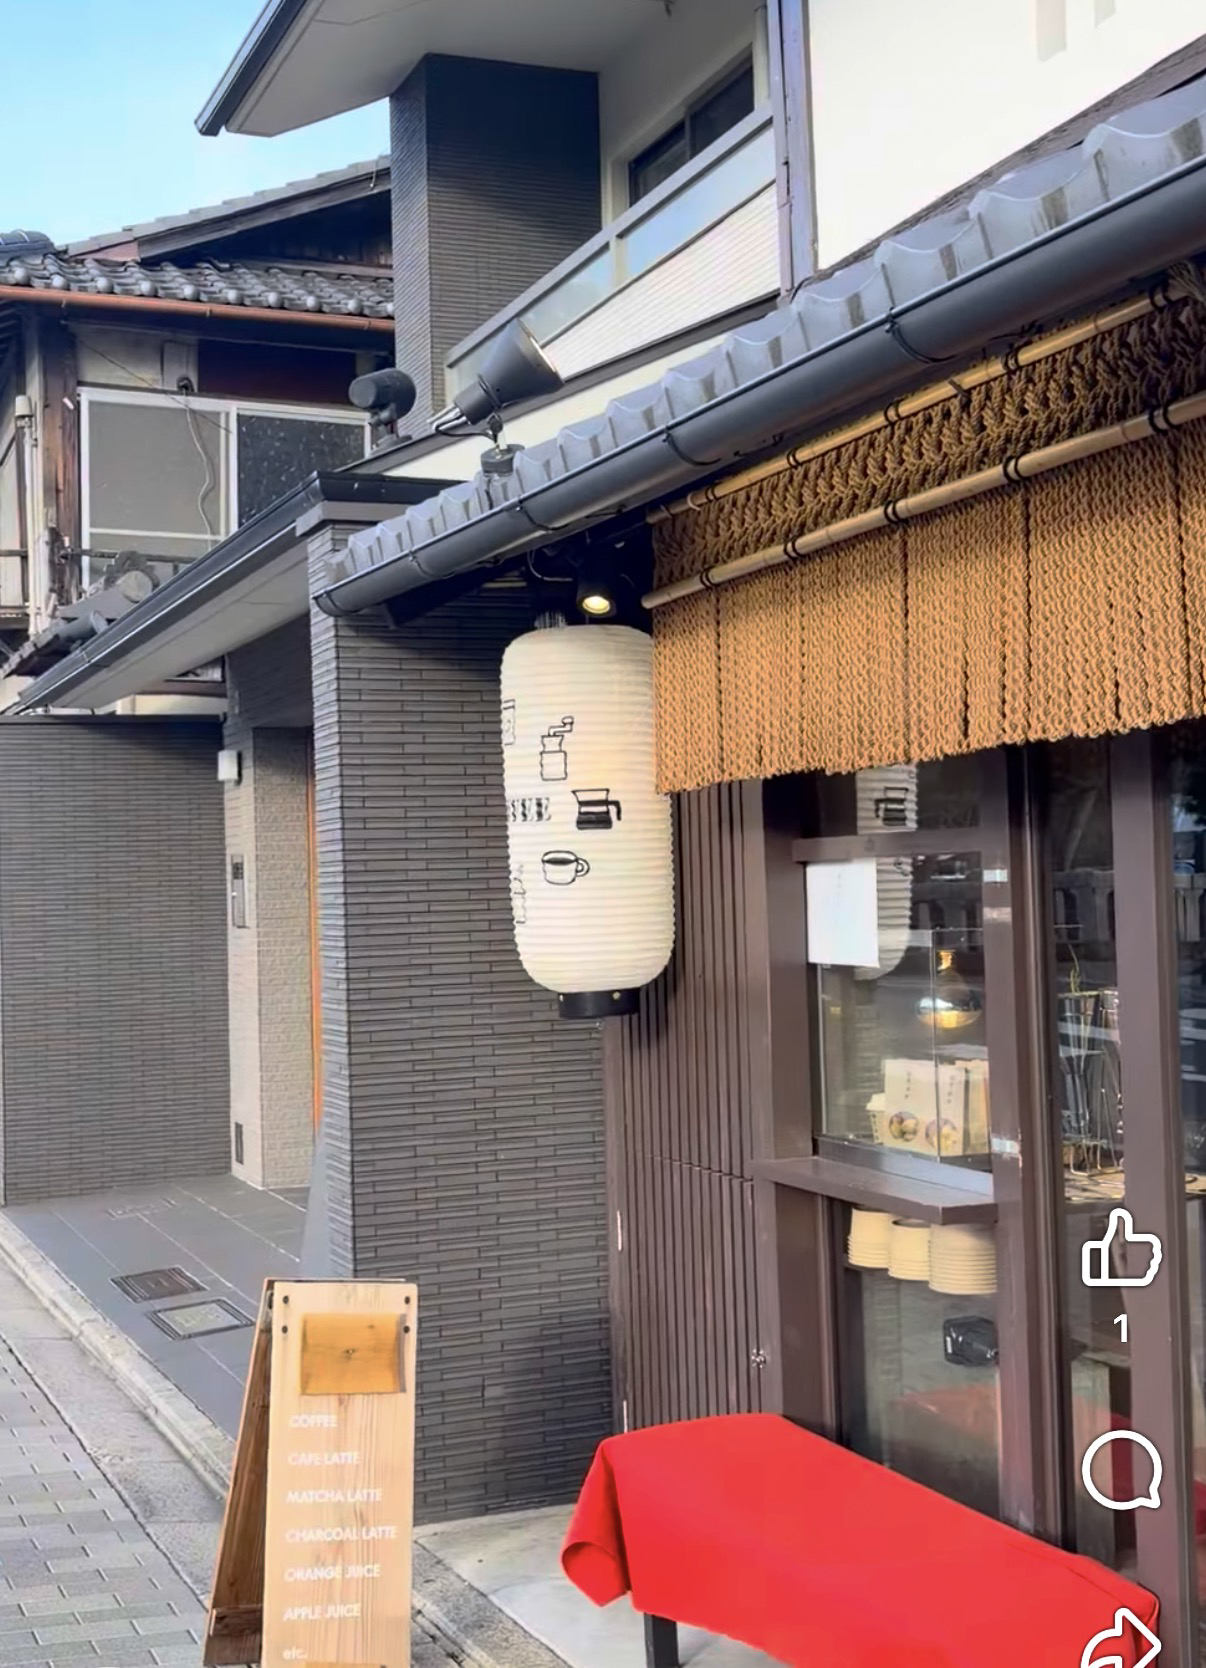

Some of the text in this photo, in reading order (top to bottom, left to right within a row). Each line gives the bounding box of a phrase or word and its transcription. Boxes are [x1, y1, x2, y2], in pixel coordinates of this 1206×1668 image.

[289, 1414, 338, 1428] COFFEE
[324, 1451, 359, 1464] LATTE
[287, 1488, 383, 1503] MATCHA LATTE
[286, 1526, 397, 1542] CHARCOAL LATTE
[285, 1564, 381, 1581] ORANGE JUICE
[283, 1604, 361, 1621] APPLE JUICE
